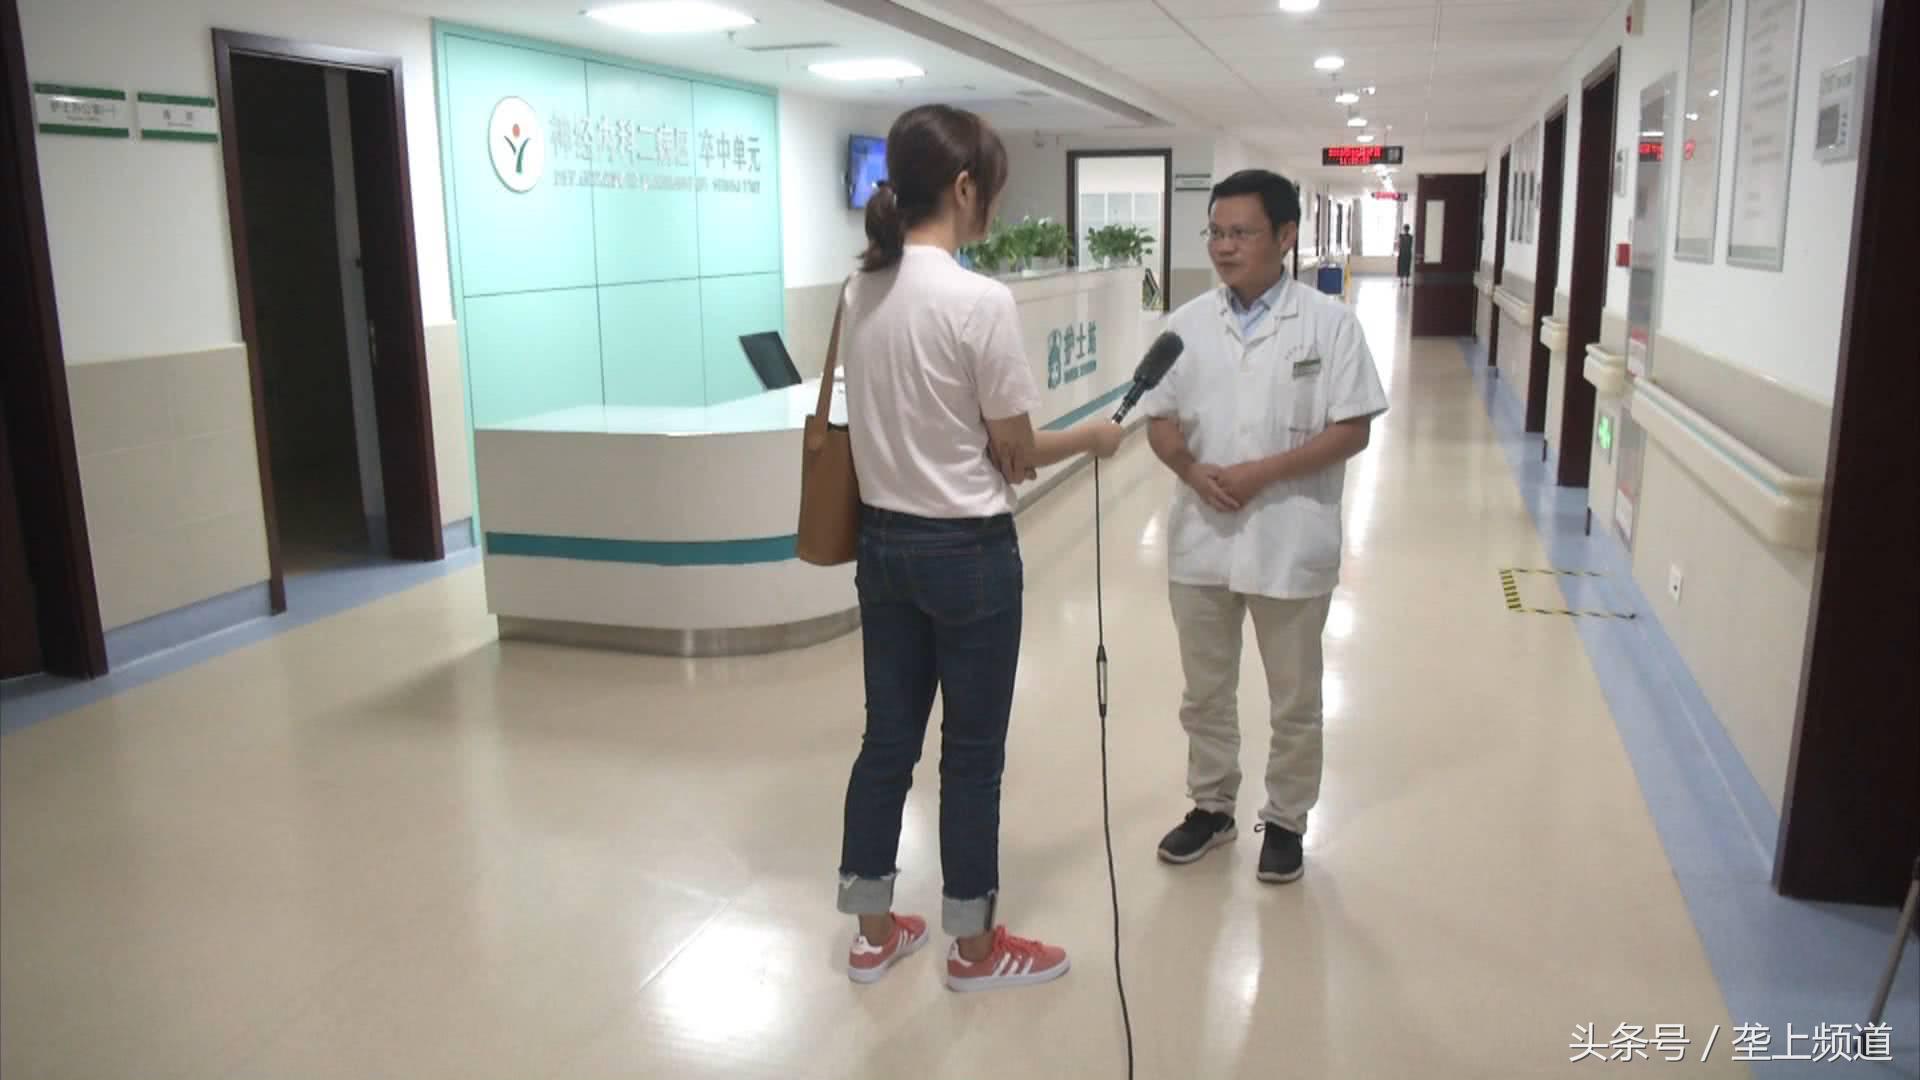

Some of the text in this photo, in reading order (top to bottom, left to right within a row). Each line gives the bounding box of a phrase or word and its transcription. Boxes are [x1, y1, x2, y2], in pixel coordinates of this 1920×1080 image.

[698, 128, 761, 173] 卒中单元
[1063, 319, 1097, 366] 护士站
